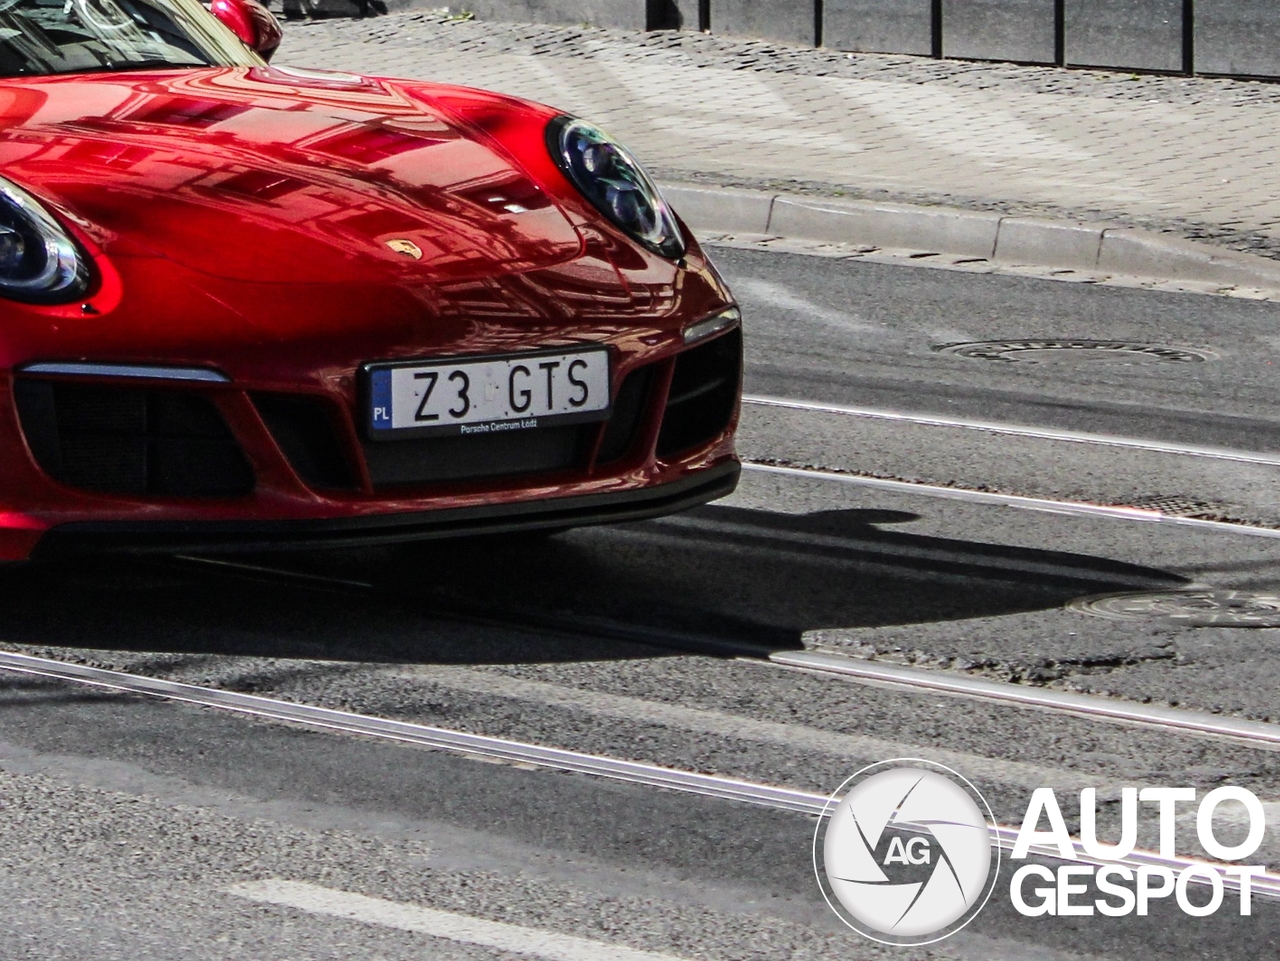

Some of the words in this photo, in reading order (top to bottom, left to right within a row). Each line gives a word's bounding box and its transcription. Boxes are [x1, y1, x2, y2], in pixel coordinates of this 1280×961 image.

[413, 370, 470, 422] Z3
[508, 359, 589, 413] GTS
[374, 407, 389, 421] PL
[461, 423, 489, 434] Porsche
[490, 421, 520, 432] Centrum
[521, 419, 538, 429] Łódź
